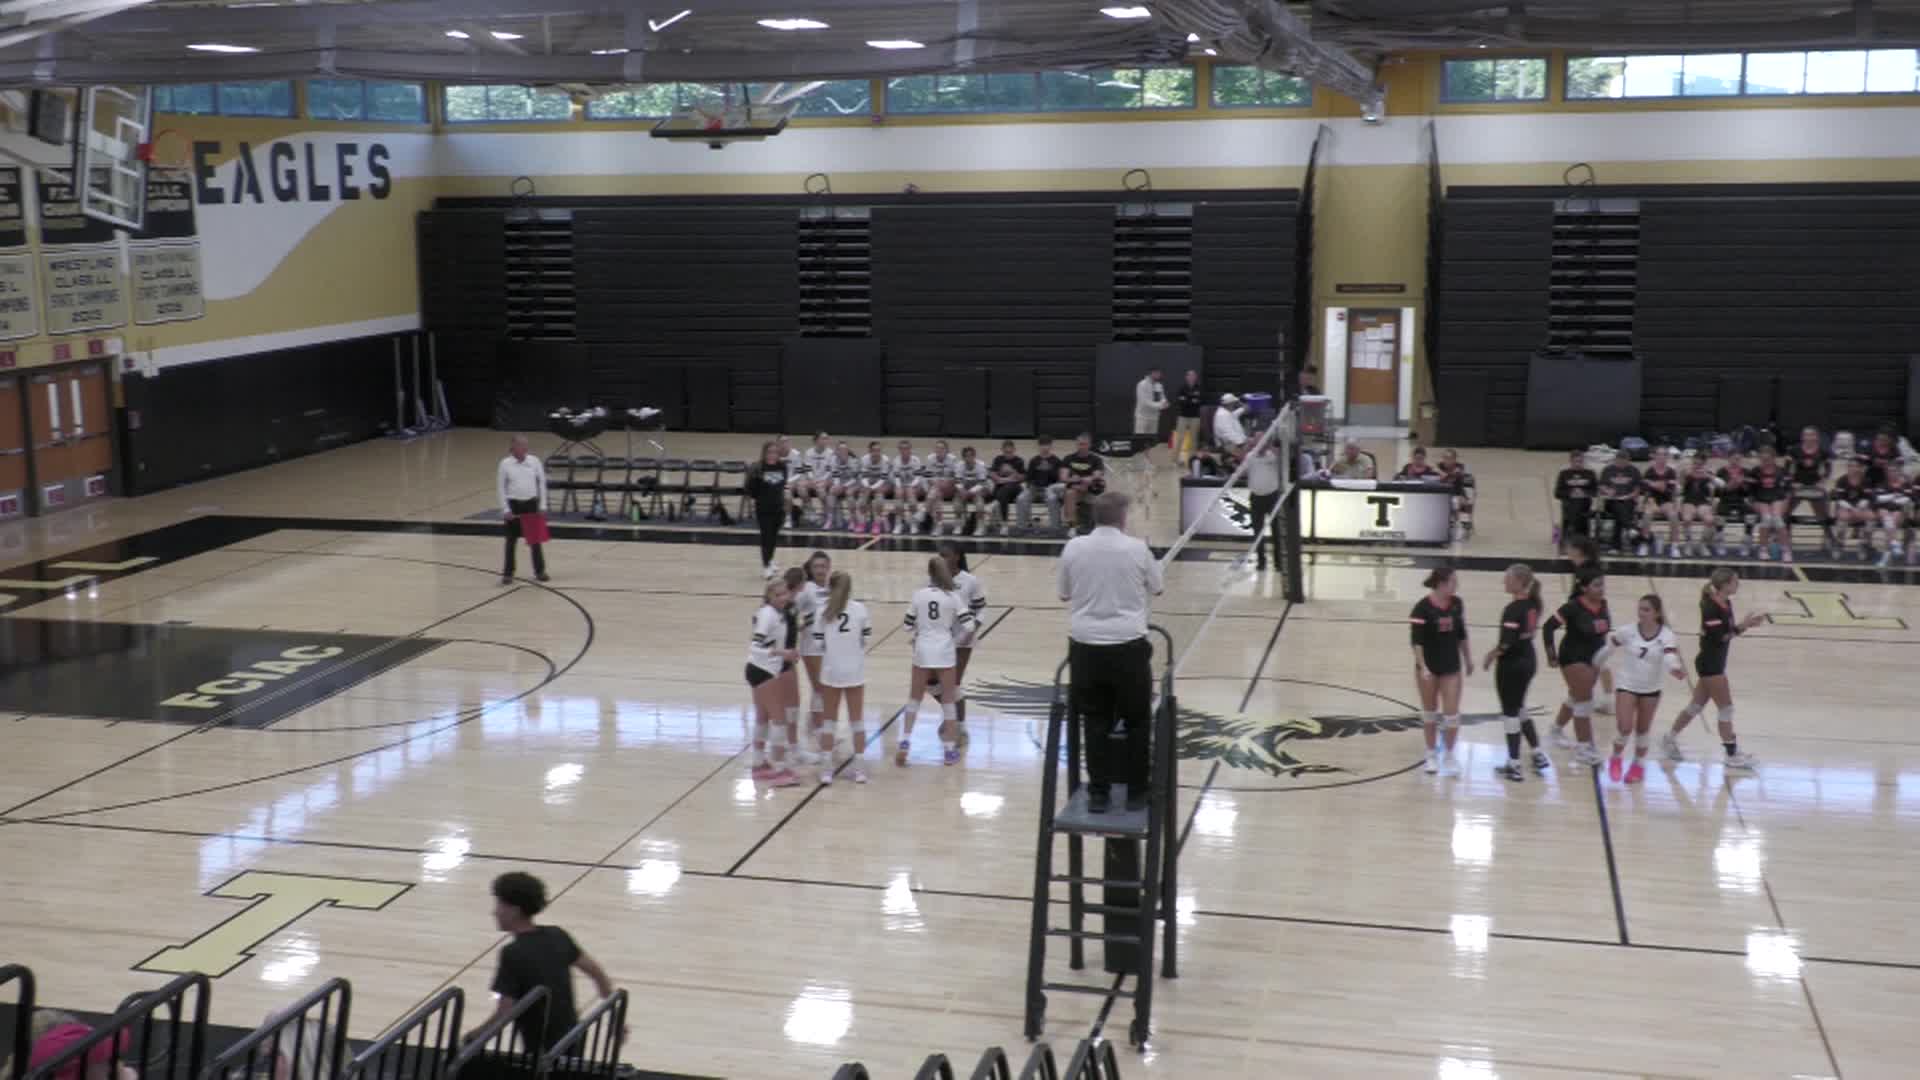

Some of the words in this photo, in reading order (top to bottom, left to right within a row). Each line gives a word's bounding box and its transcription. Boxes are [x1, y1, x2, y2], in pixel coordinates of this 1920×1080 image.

[194, 141, 391, 204] EAGLES
[1368, 496, 1399, 527] T
[838, 612, 850, 633] 2
[928, 601, 940, 621] 8
[1638, 646, 1649, 659] 7
[160, 645, 344, 709] FCIAC
[131, 869, 416, 978] T
